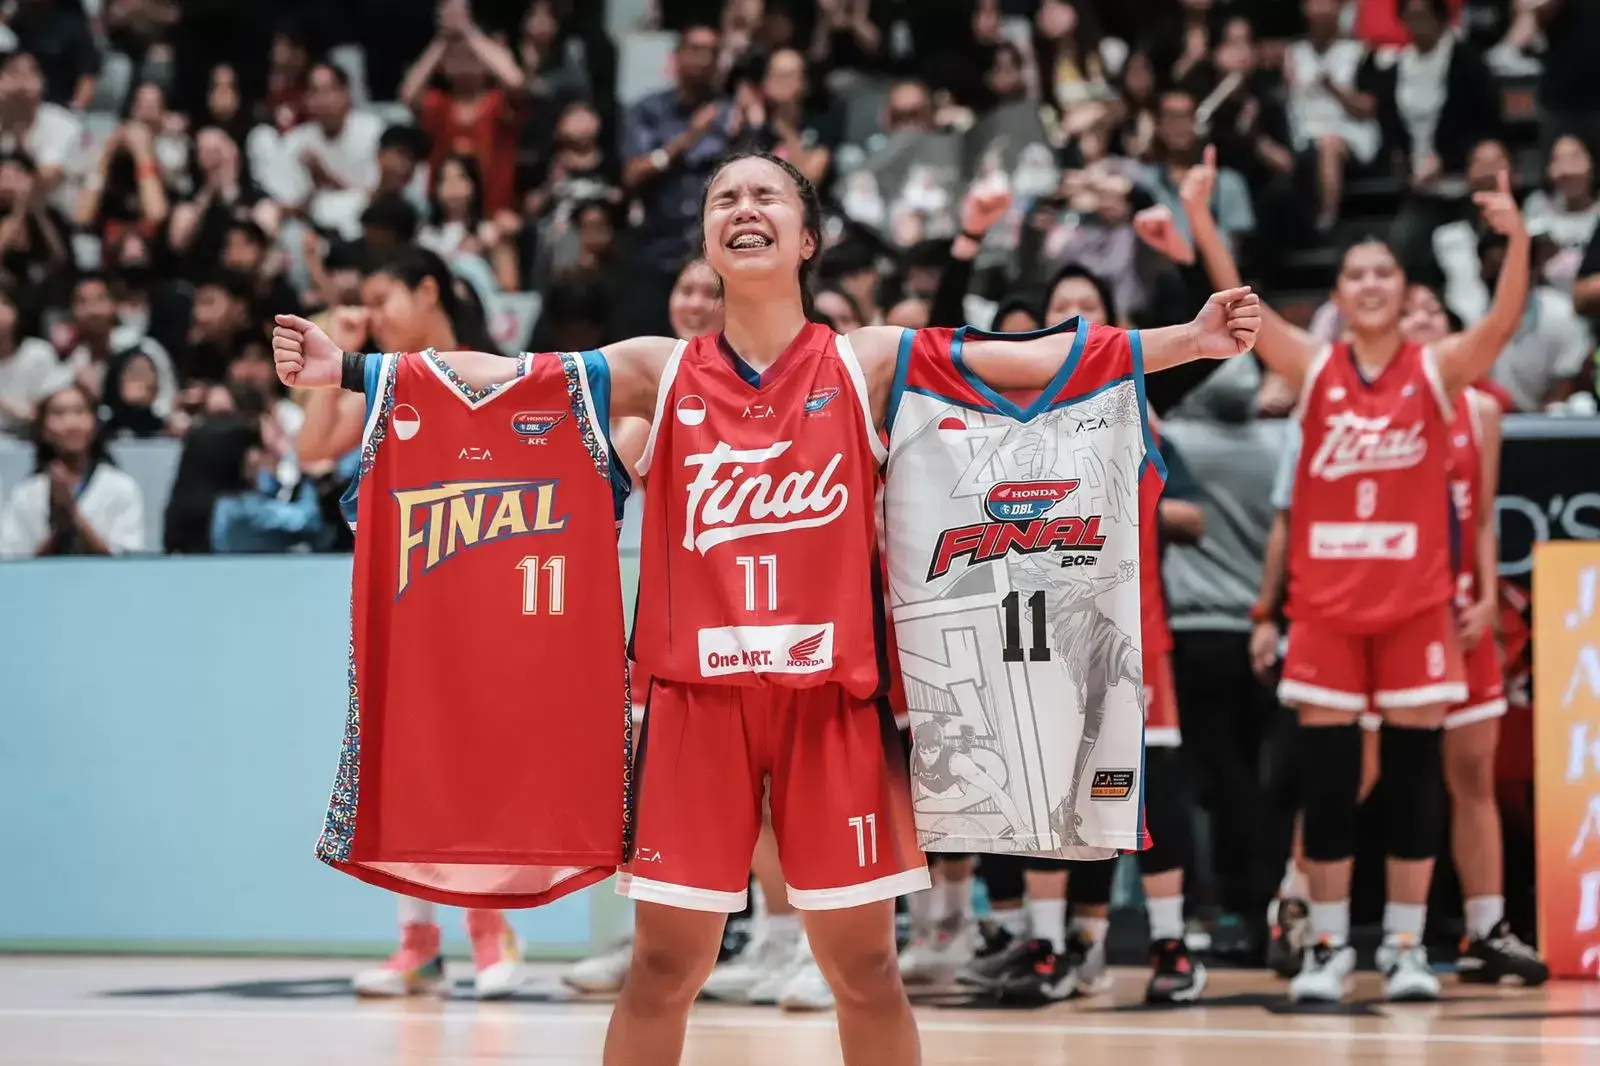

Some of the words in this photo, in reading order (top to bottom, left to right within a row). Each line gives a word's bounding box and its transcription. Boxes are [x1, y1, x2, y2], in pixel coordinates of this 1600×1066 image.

[682, 440, 849, 557] Final
[1010, 503, 1034, 515] DBL
[1012, 488, 1059, 498] HONDA
[391, 479, 570, 602] FINAL
[926, 515, 1107, 583] FINAL
[515, 556, 565, 615] 11
[736, 554, 777, 611] 11
[1002, 590, 1051, 662] 11
[707, 652, 739, 669] One
[786, 658, 825, 667] HONDA
[848, 813, 877, 867] 11
